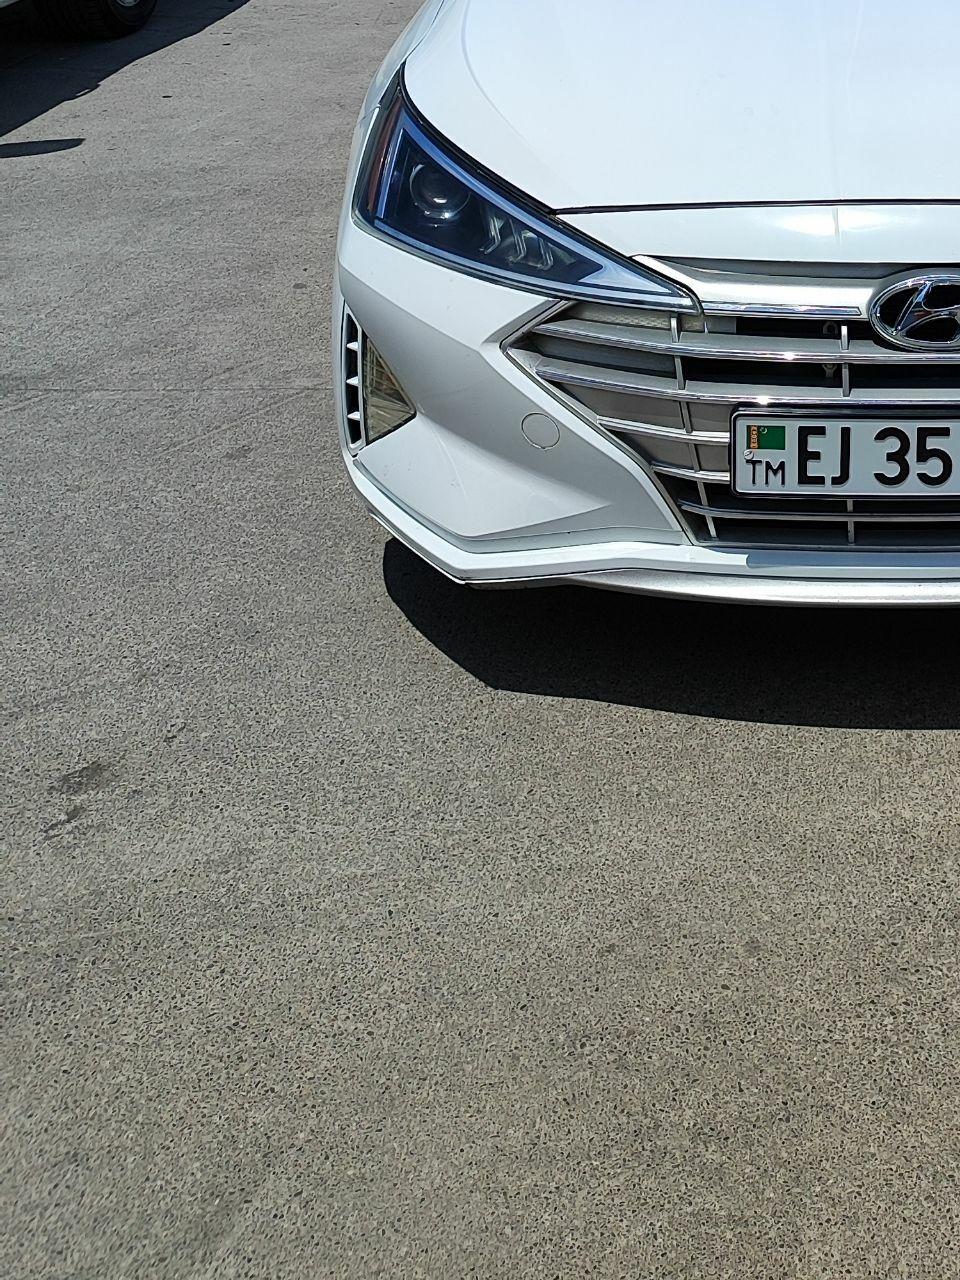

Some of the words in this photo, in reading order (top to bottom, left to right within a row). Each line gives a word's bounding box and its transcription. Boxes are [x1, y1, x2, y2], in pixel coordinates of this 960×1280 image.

[746, 459, 786, 486] TM
[797, 426, 851, 486] EJ
[873, 426, 953, 486] 35
